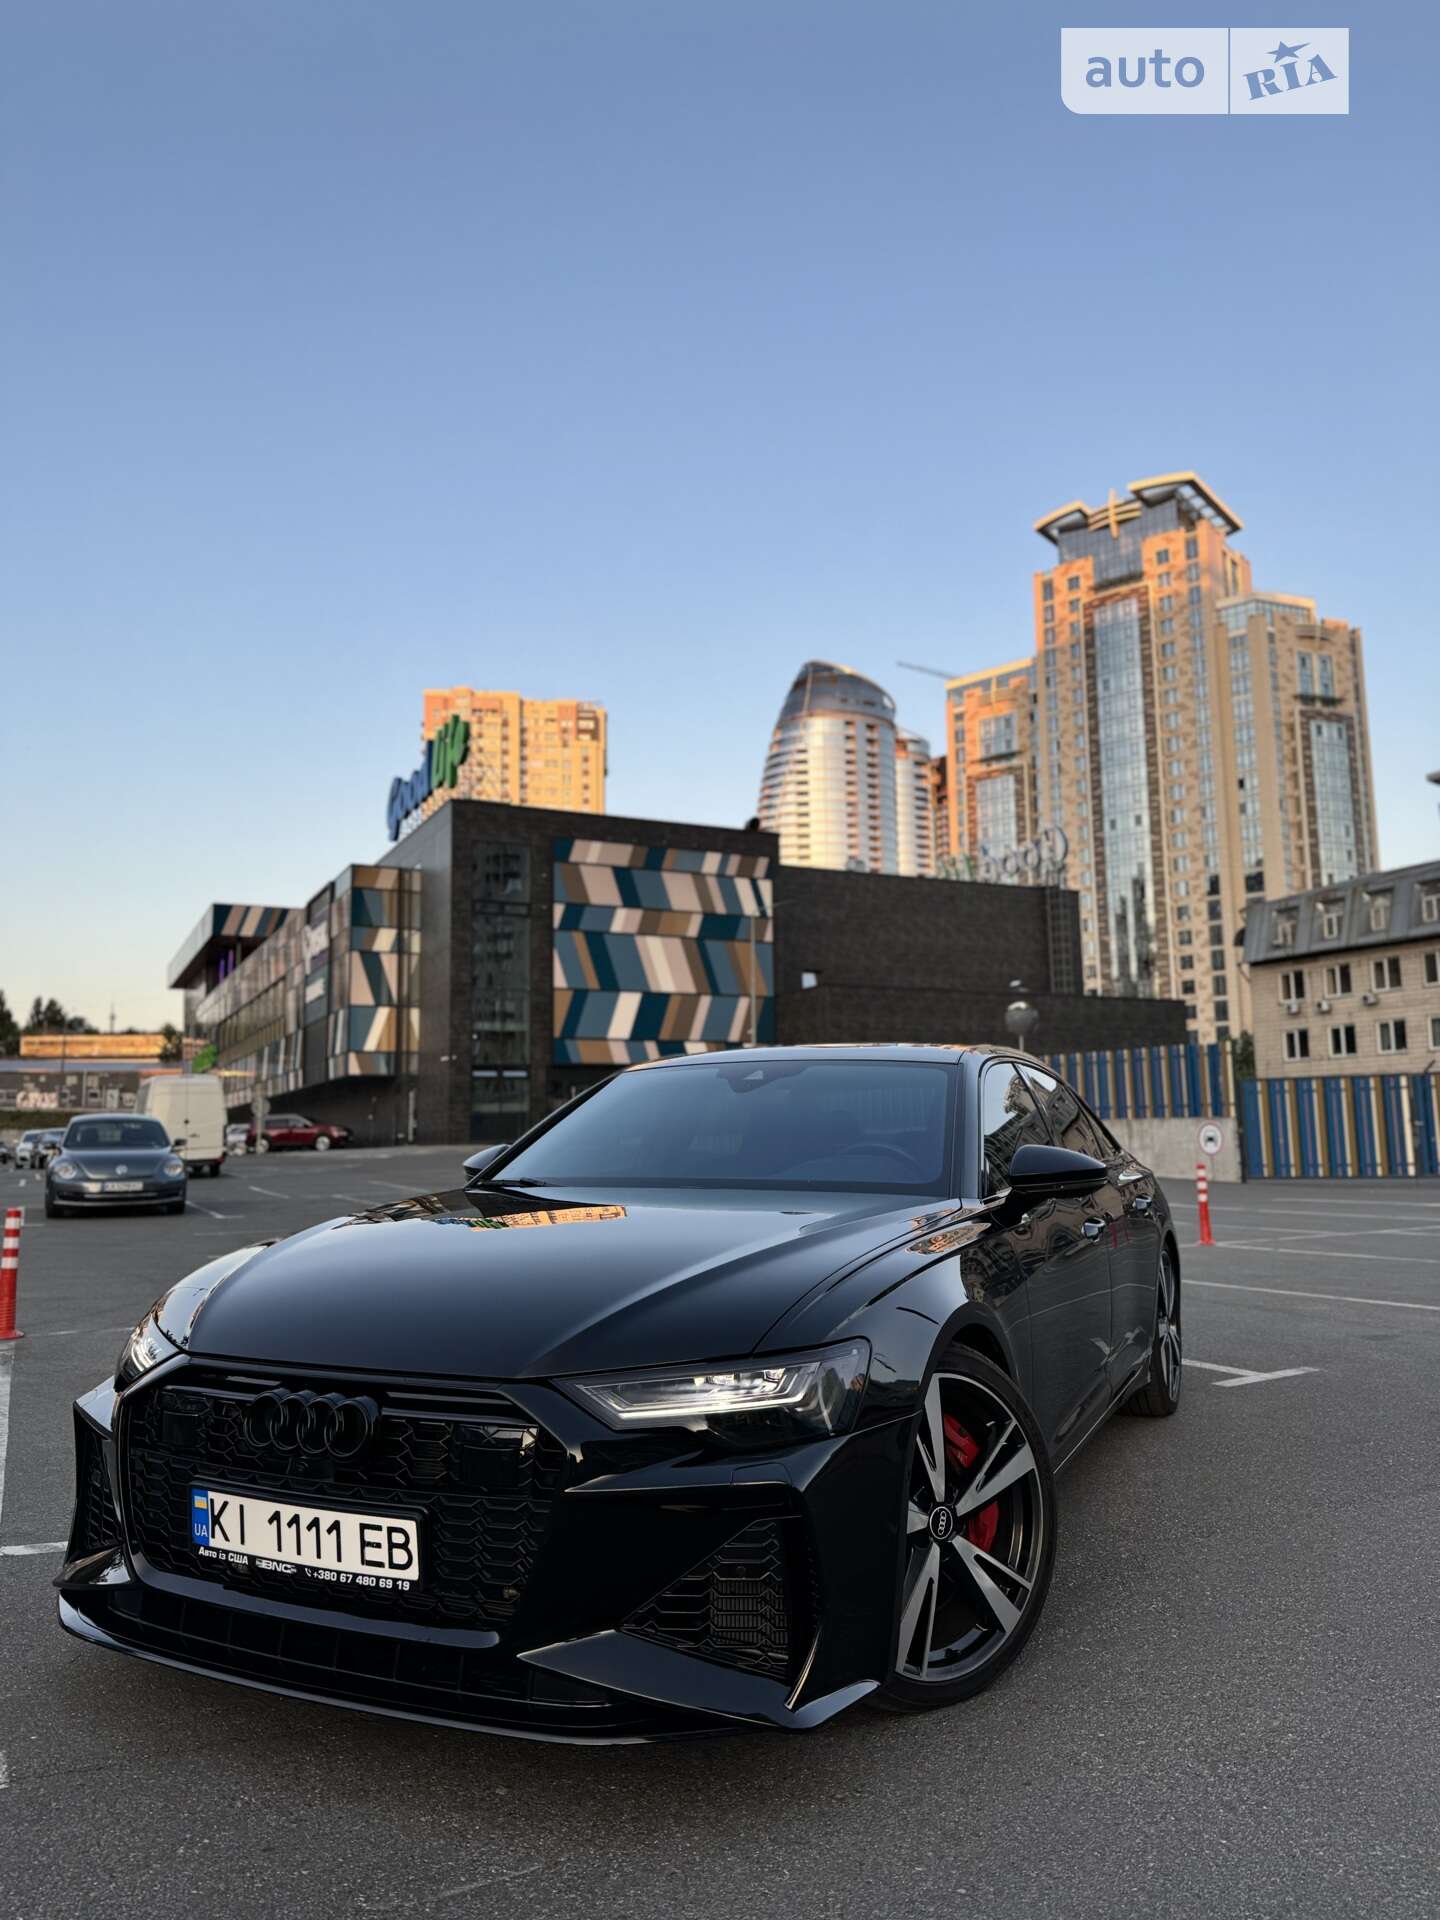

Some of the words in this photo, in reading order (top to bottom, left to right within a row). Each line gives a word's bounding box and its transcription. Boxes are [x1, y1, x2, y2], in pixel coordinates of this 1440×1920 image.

[194, 1523, 208, 1537] UA
[210, 1498, 246, 1546] KI
[267, 1510, 342, 1563] 1111
[359, 1523, 414, 1571] EB
[198, 1546, 217, 1558] Авто
[218, 1550, 226, 1561] із
[228, 1553, 248, 1565] США
[313, 1570, 337, 1581] +380
[339, 1574, 352, 1583] 67
[356, 1576, 376, 1587] 480
[379, 1579, 393, 1589] 69
[396, 1580, 410, 1591] 19
